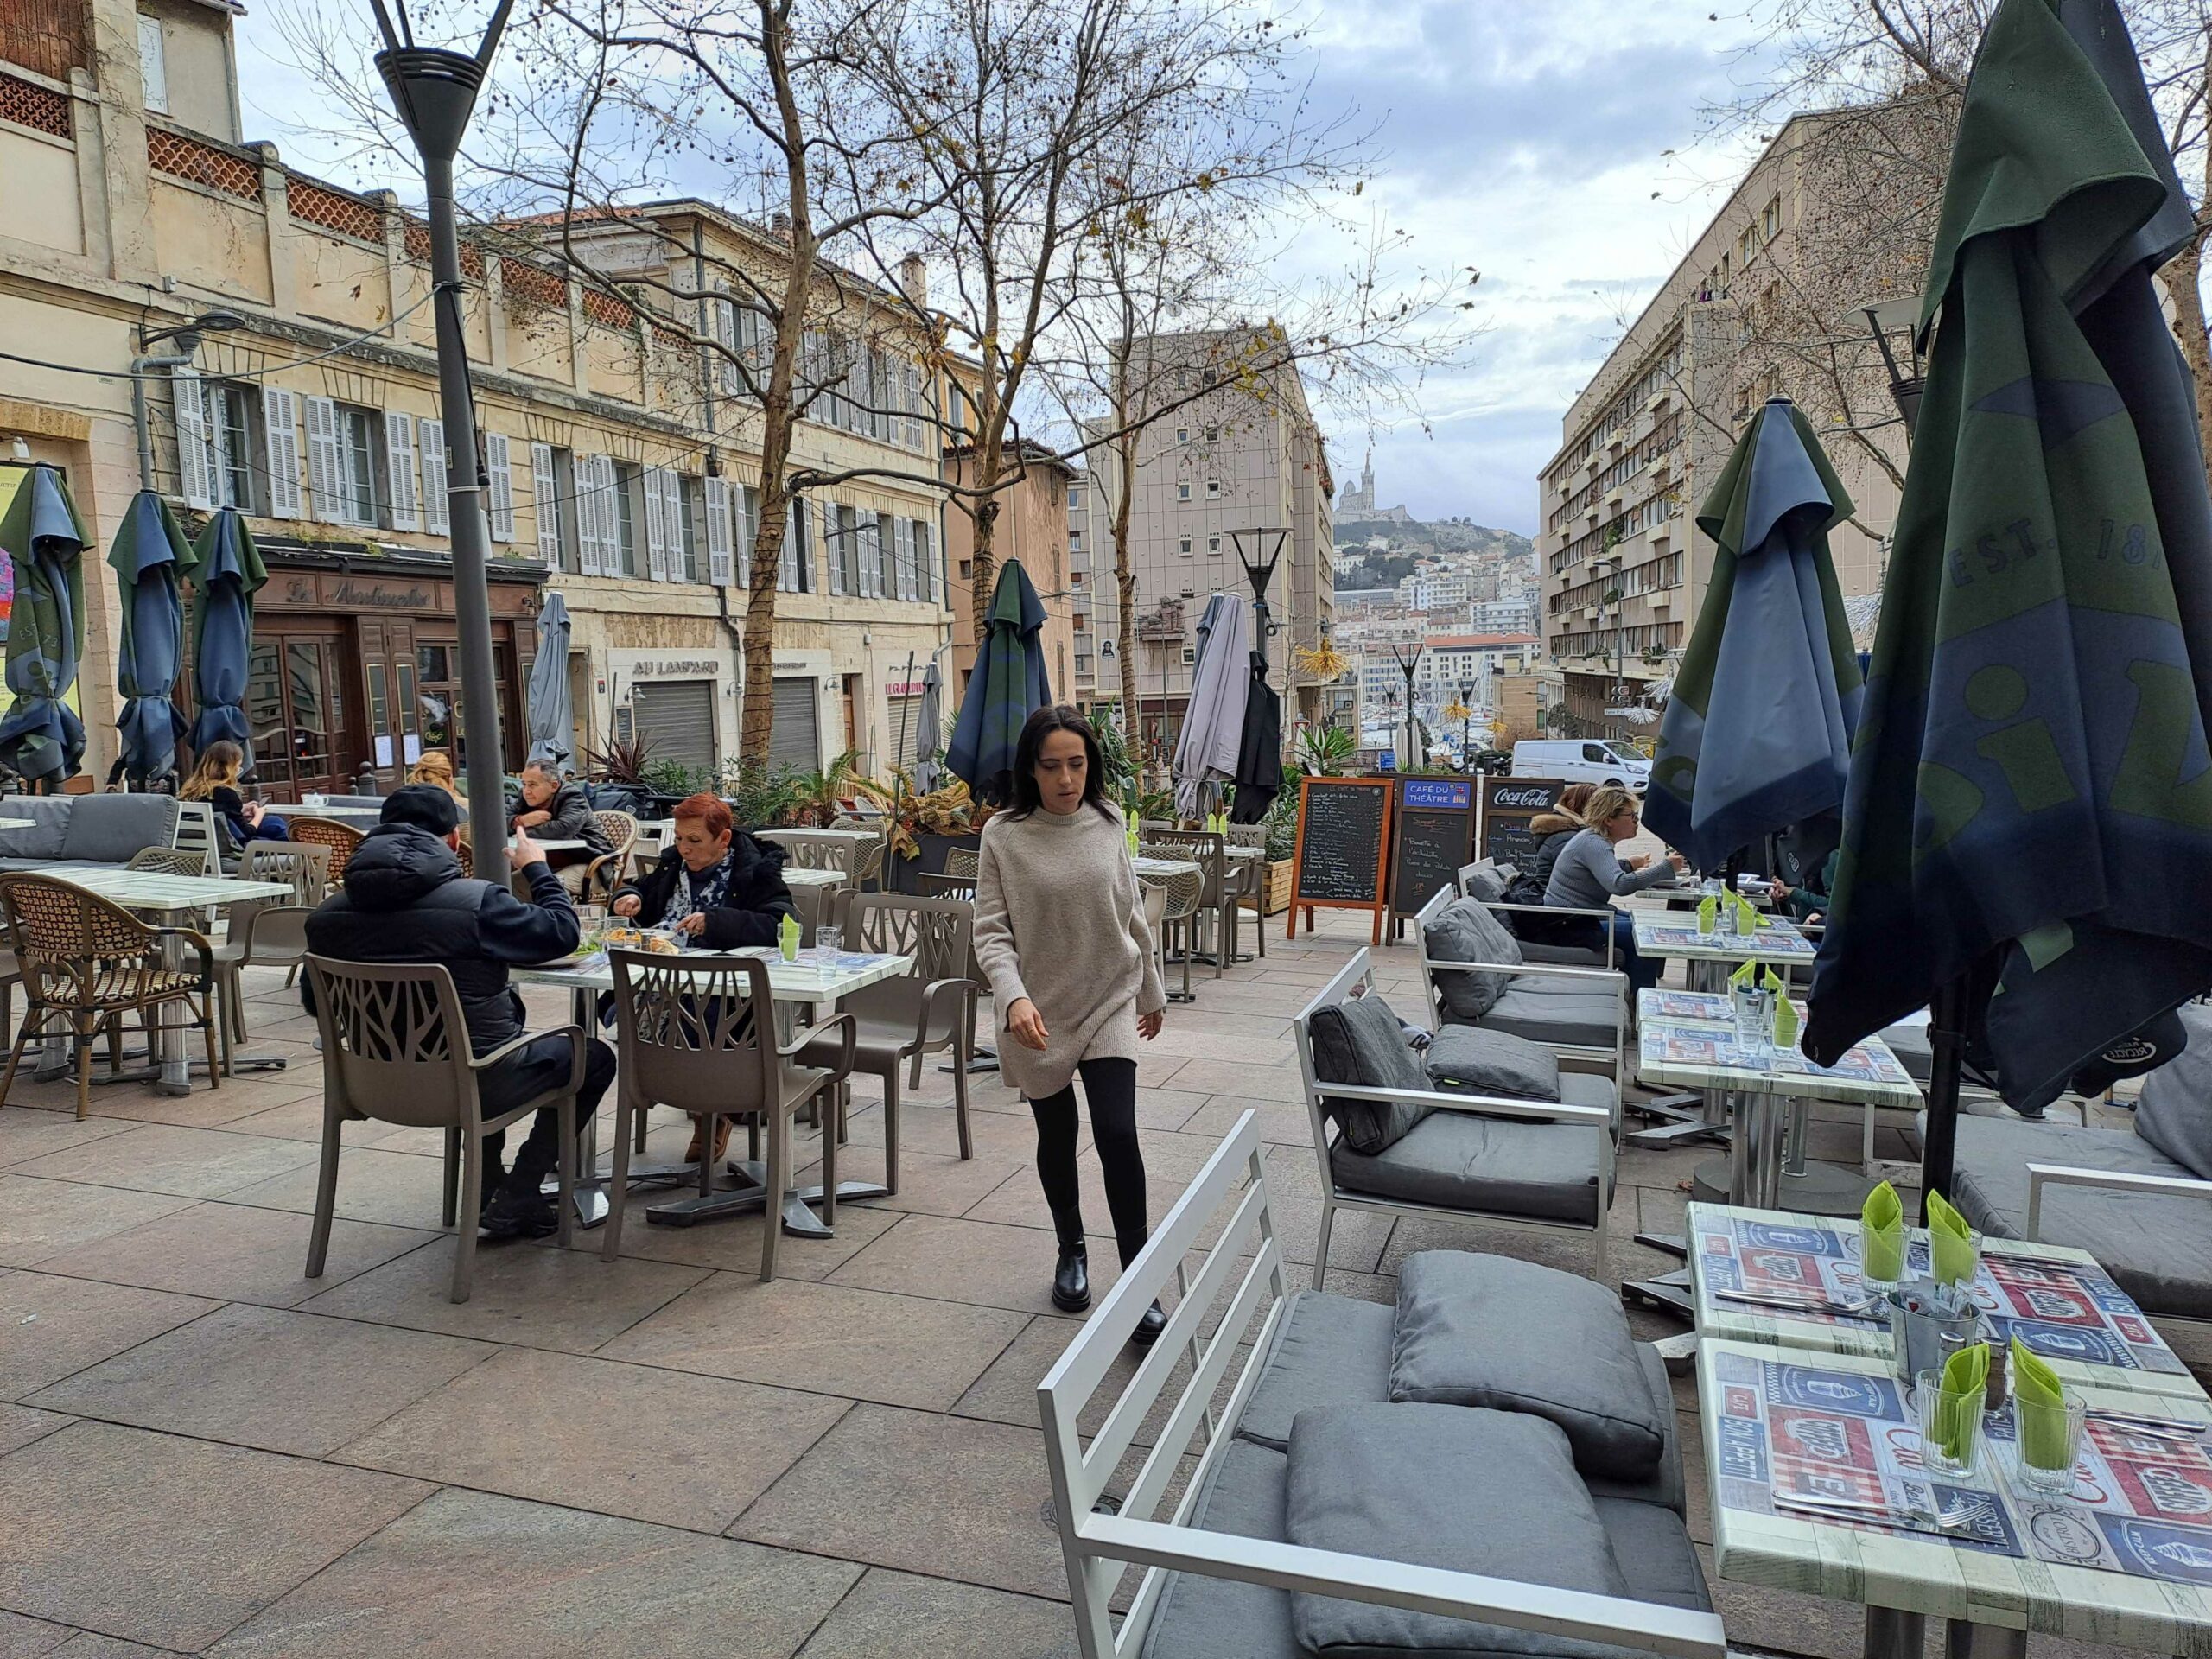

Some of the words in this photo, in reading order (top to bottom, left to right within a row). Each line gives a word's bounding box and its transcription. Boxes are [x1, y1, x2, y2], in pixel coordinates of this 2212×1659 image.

[2096, 518, 2164, 570] 18
[633, 662, 654, 676] AU
[1408, 794, 1449, 803] THÉÂTRE
[1409, 785, 1433, 793] CAFÉ
[1494, 788, 1552, 807] Coca-Cola
[1724, 1419, 1754, 1440] BON
[1725, 1438, 1758, 1479] APPETIT
[2048, 1514, 2082, 1555] BISTROT
[2130, 1530, 2145, 1549] CALM
